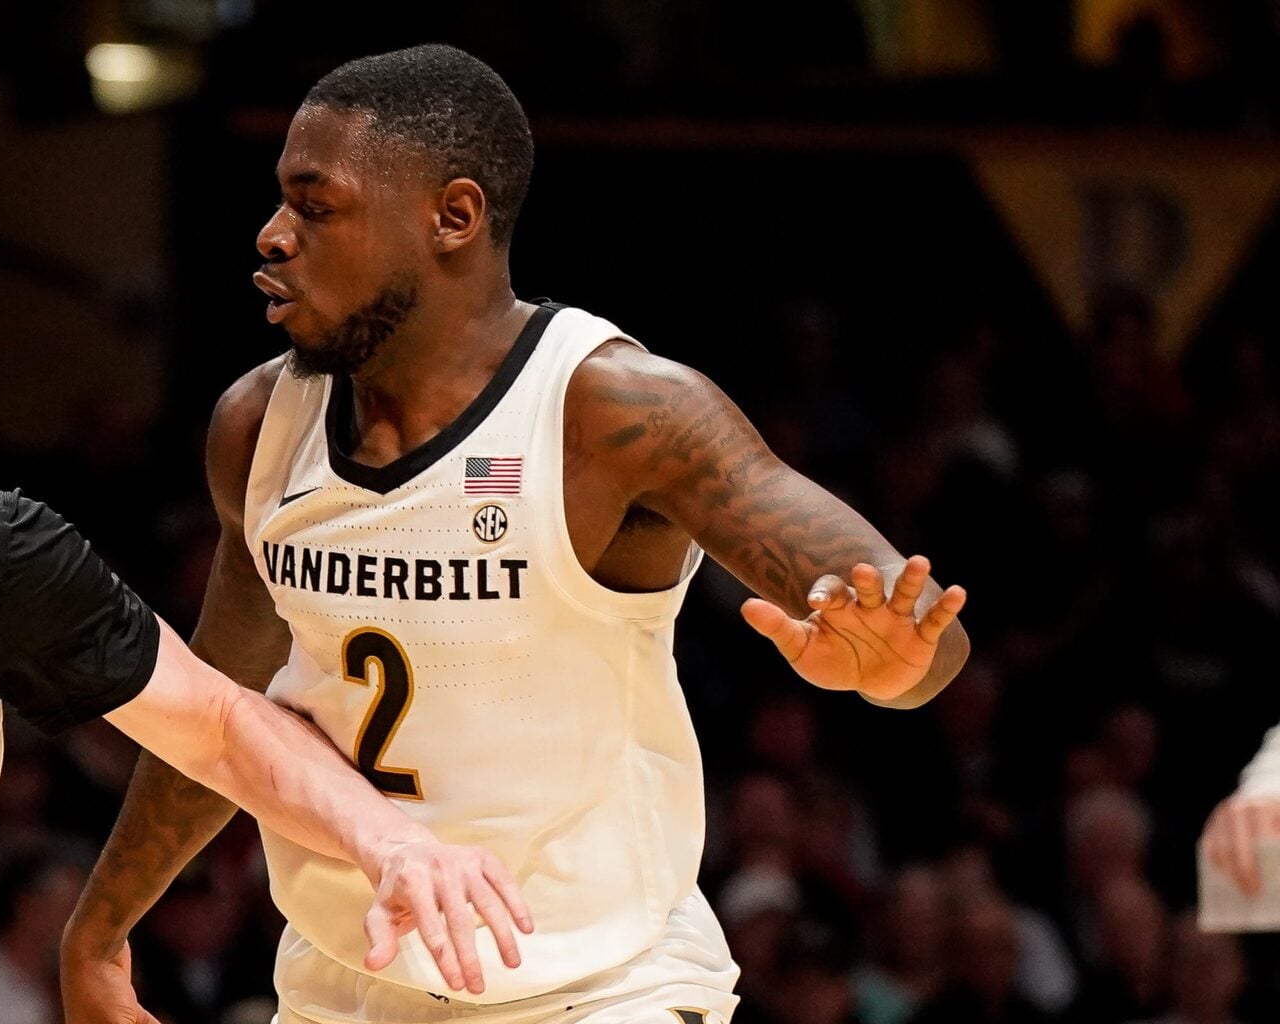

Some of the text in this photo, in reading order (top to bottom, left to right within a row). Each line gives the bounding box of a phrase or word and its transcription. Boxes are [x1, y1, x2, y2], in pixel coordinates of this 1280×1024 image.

[475, 506, 507, 541] SEC
[262, 540, 528, 602] VANDERBILT
[341, 626, 424, 801] 2
